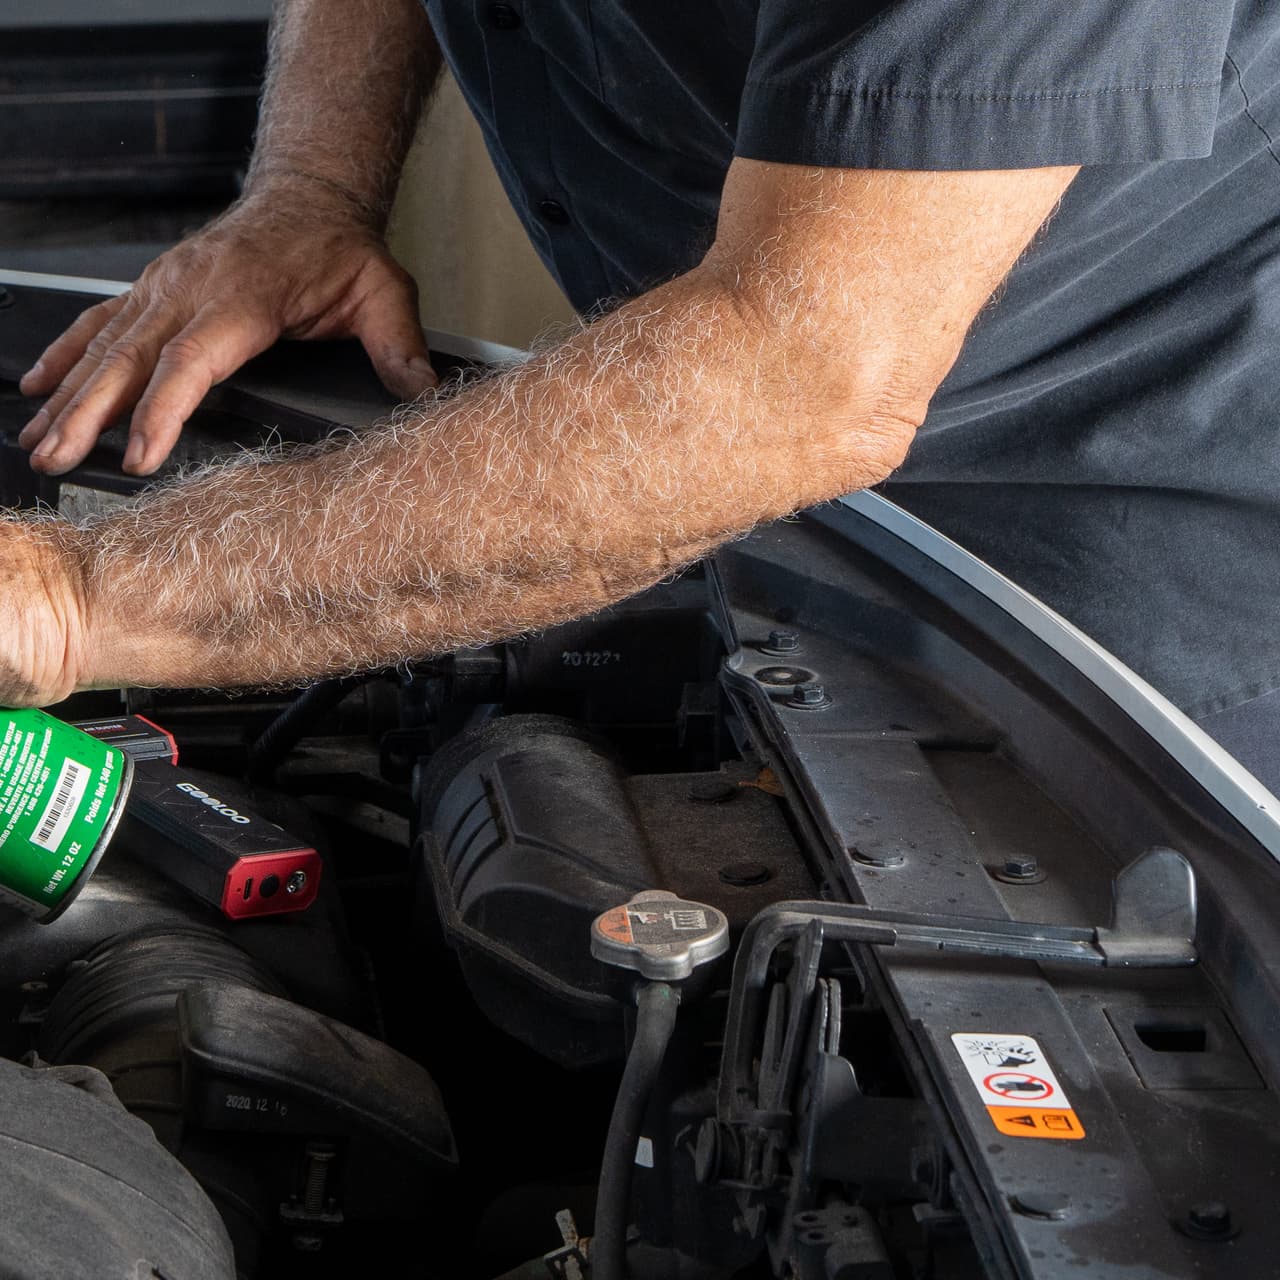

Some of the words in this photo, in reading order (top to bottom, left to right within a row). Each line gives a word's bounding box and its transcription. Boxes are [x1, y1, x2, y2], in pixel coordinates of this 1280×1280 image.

[100, 767, 111, 783] 340
[95, 782, 107, 798] Net
[84, 798, 101, 823] Poids
[176, 782, 250, 824] GOOLOO
[44, 880, 58, 893] Net
[62, 855, 74, 866] 12
[69, 842, 81, 854] OZ
